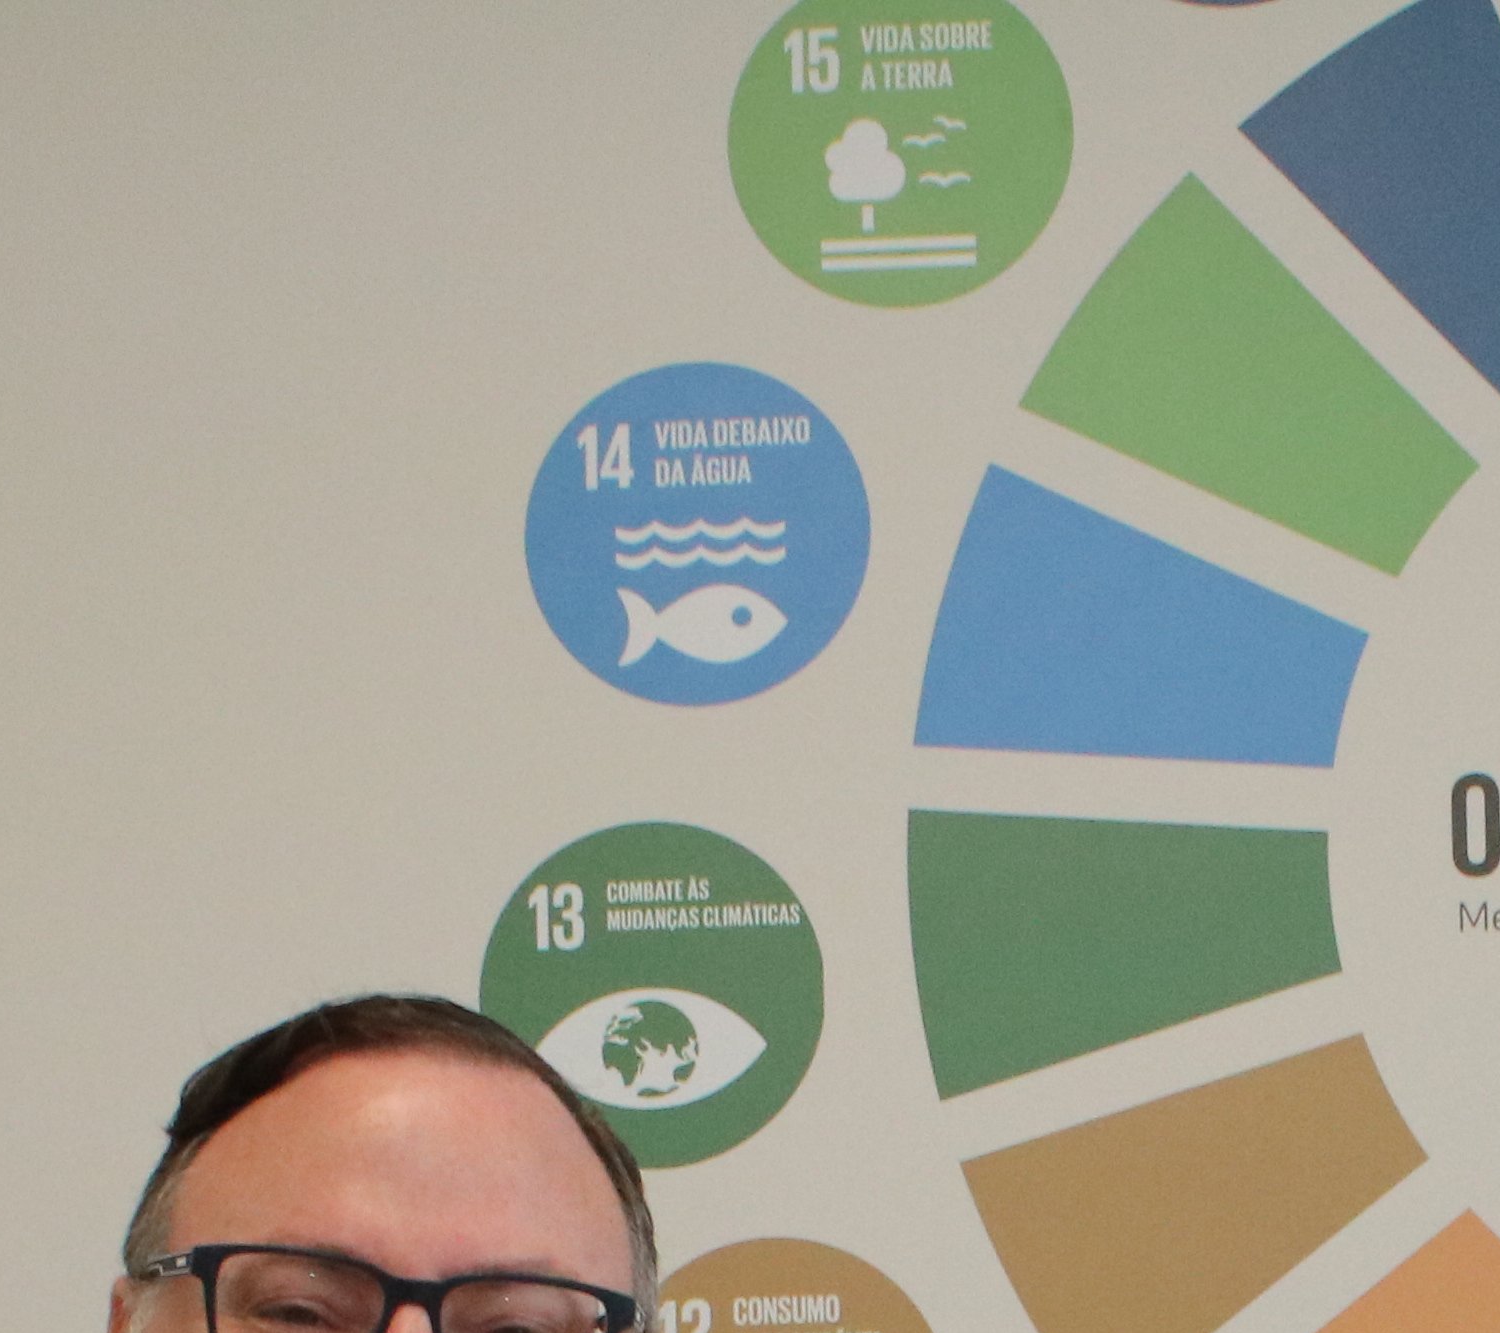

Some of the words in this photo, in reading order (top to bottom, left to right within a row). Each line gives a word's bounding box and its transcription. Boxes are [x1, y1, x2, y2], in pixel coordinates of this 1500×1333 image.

[860, 24, 913, 54] VIDA
[919, 20, 993, 52] SOBRE
[784, 27, 840, 95] 15
[861, 63, 877, 92] A
[883, 59, 954, 91] TERRA
[654, 419, 709, 450] VIDA
[712, 415, 812, 447] DEBAIXO
[576, 422, 635, 492] 14
[655, 457, 686, 488] DA
[691, 451, 752, 487] ÁGUA
[606, 878, 684, 905] COMBATE
[687, 875, 711, 902] ÀS
[527, 882, 585, 952] 13
[606, 905, 700, 932] MUDANÇAS
[703, 901, 801, 929] CLIMÁTICAS
[733, 1293, 841, 1326] CONSUMO
